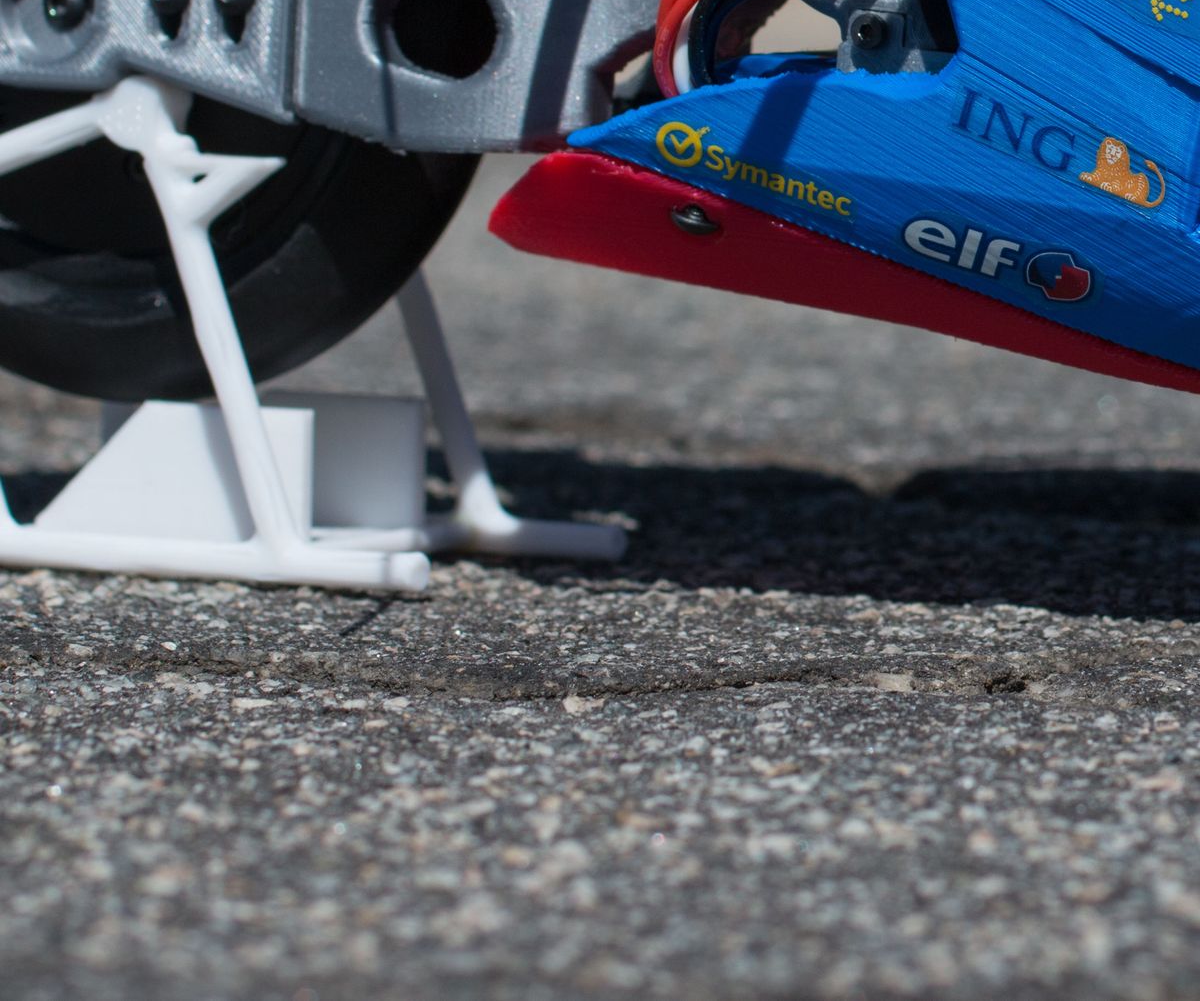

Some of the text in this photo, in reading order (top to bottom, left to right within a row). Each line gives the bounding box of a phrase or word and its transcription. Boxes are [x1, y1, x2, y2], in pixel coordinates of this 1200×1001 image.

[952, 87, 1077, 172] ING
[704, 145, 851, 216] Symantec
[904, 219, 1020, 277] elf
